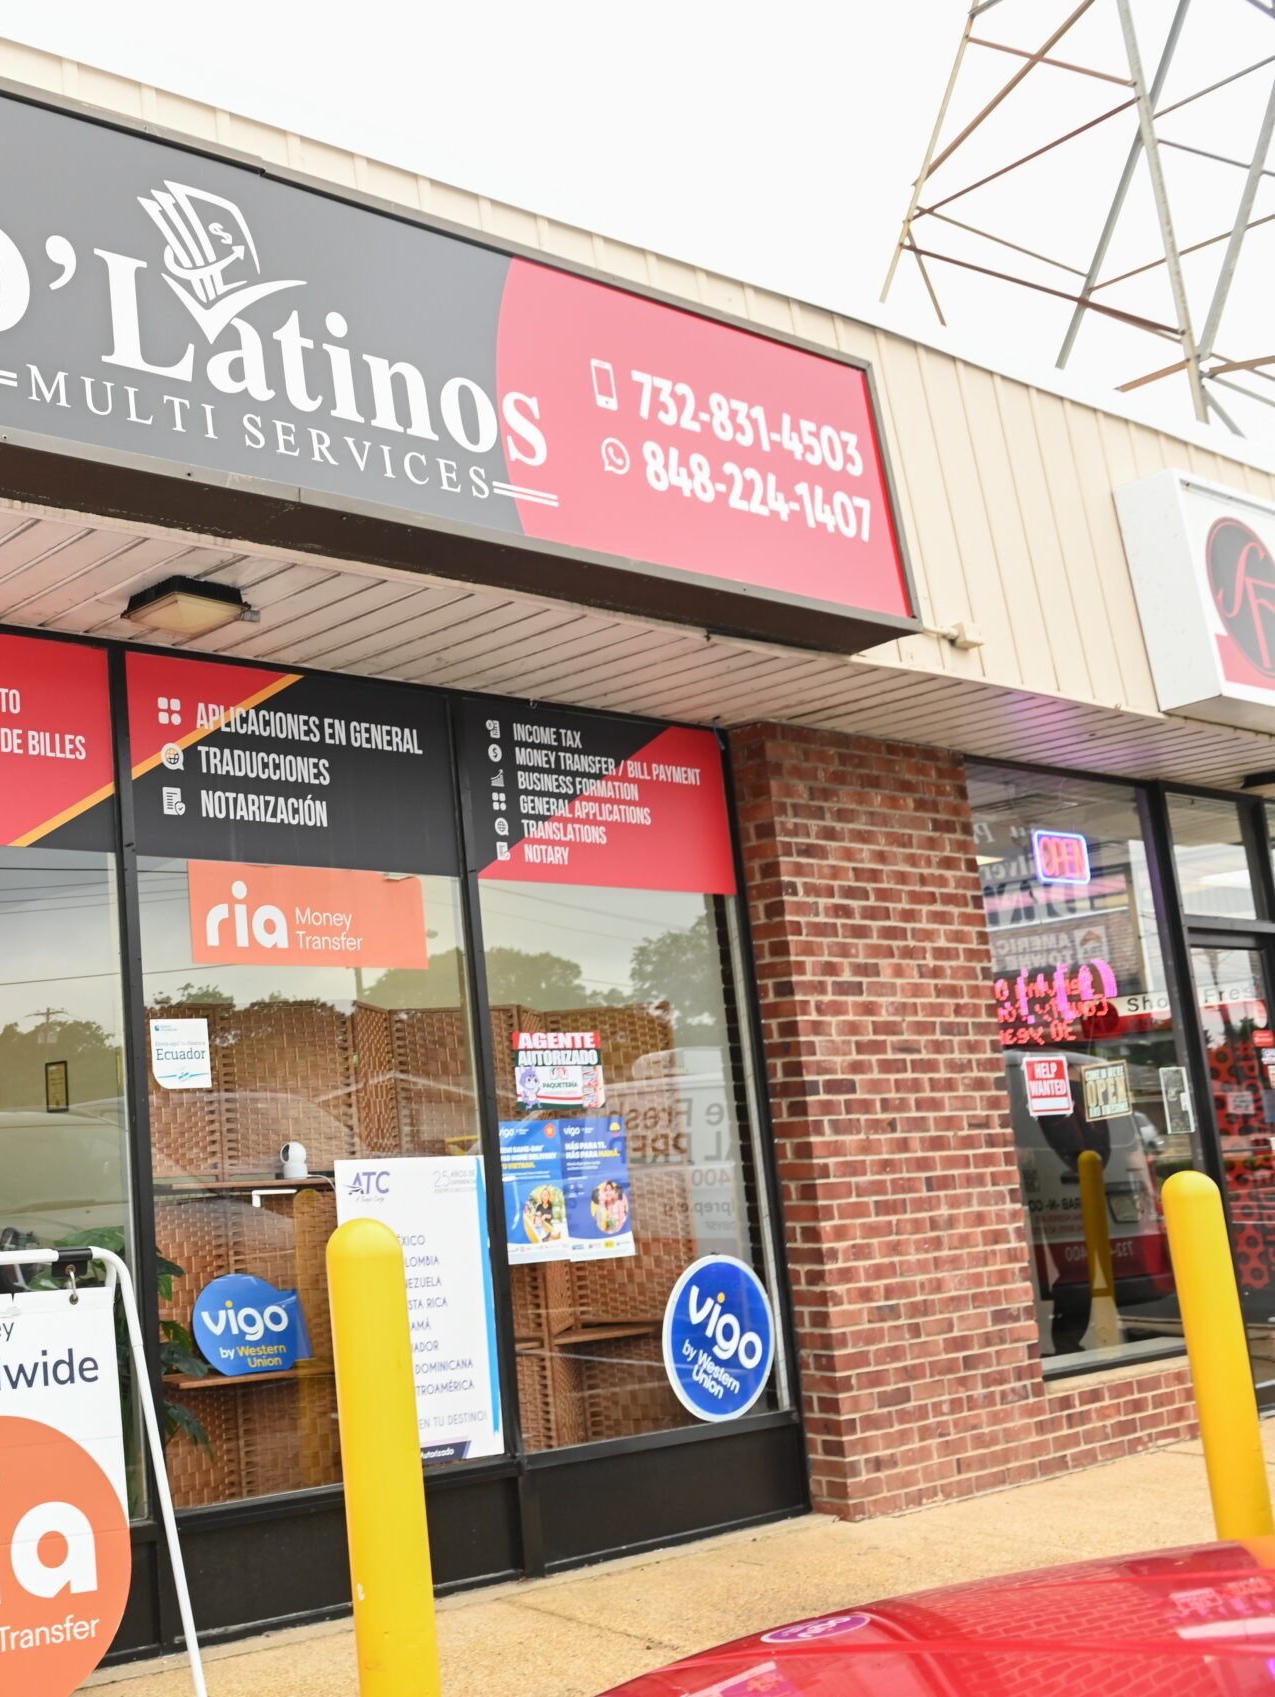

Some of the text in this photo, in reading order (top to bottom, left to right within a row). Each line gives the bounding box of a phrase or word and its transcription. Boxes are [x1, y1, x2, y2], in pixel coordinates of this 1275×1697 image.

[26, 364, 490, 498] MULTI SERVICES
[631, 370, 863, 476] 732-831-4503
[643, 441, 871, 542] 848-224-1407
[0, 728, 24, 755] DE
[28, 730, 86, 760] BILLES
[196, 702, 423, 755] APLICACIONES EN GENERAL
[513, 723, 583, 749] INCOME TAX
[197, 745, 331, 785] TRADUCCIONES
[515, 747, 701, 786] MONEY TRANSFER / BILL PAYMENT
[517, 771, 639, 801] BUSINESS FORMATION
[200, 789, 328, 828] NOTARIZACIÓN
[519, 795, 652, 826] GENERAL APPLICATIONS
[521, 819, 607, 845] TRANSLATIONS
[524, 844, 569, 866] NOTARY
[1039, 837, 1084, 879] OPEN
[206, 880, 352, 949] ria Money
[296, 929, 363, 953] Transfer
[156, 1048, 205, 1061] Ecuador
[518, 1032, 596, 1049] AGENTE
[518, 1049, 598, 1066] AUTORIZADO
[1034, 1063, 1058, 1078] HELP
[1030, 1080, 1067, 1097] WANTED
[1086, 1076, 1127, 1107] OPEN
[349, 1171, 391, 1195] ATC
[427, 1297, 447, 1308] RICA
[201, 1300, 289, 1341] vigo
[689, 1285, 763, 1369] vigo
[219, 1345, 287, 1360] by Western
[247, 1357, 282, 1368] Union
[415, 1359, 473, 1374] DOMINICANA
[682, 1339, 741, 1394] by Western
[692, 1364, 724, 1400] Union
